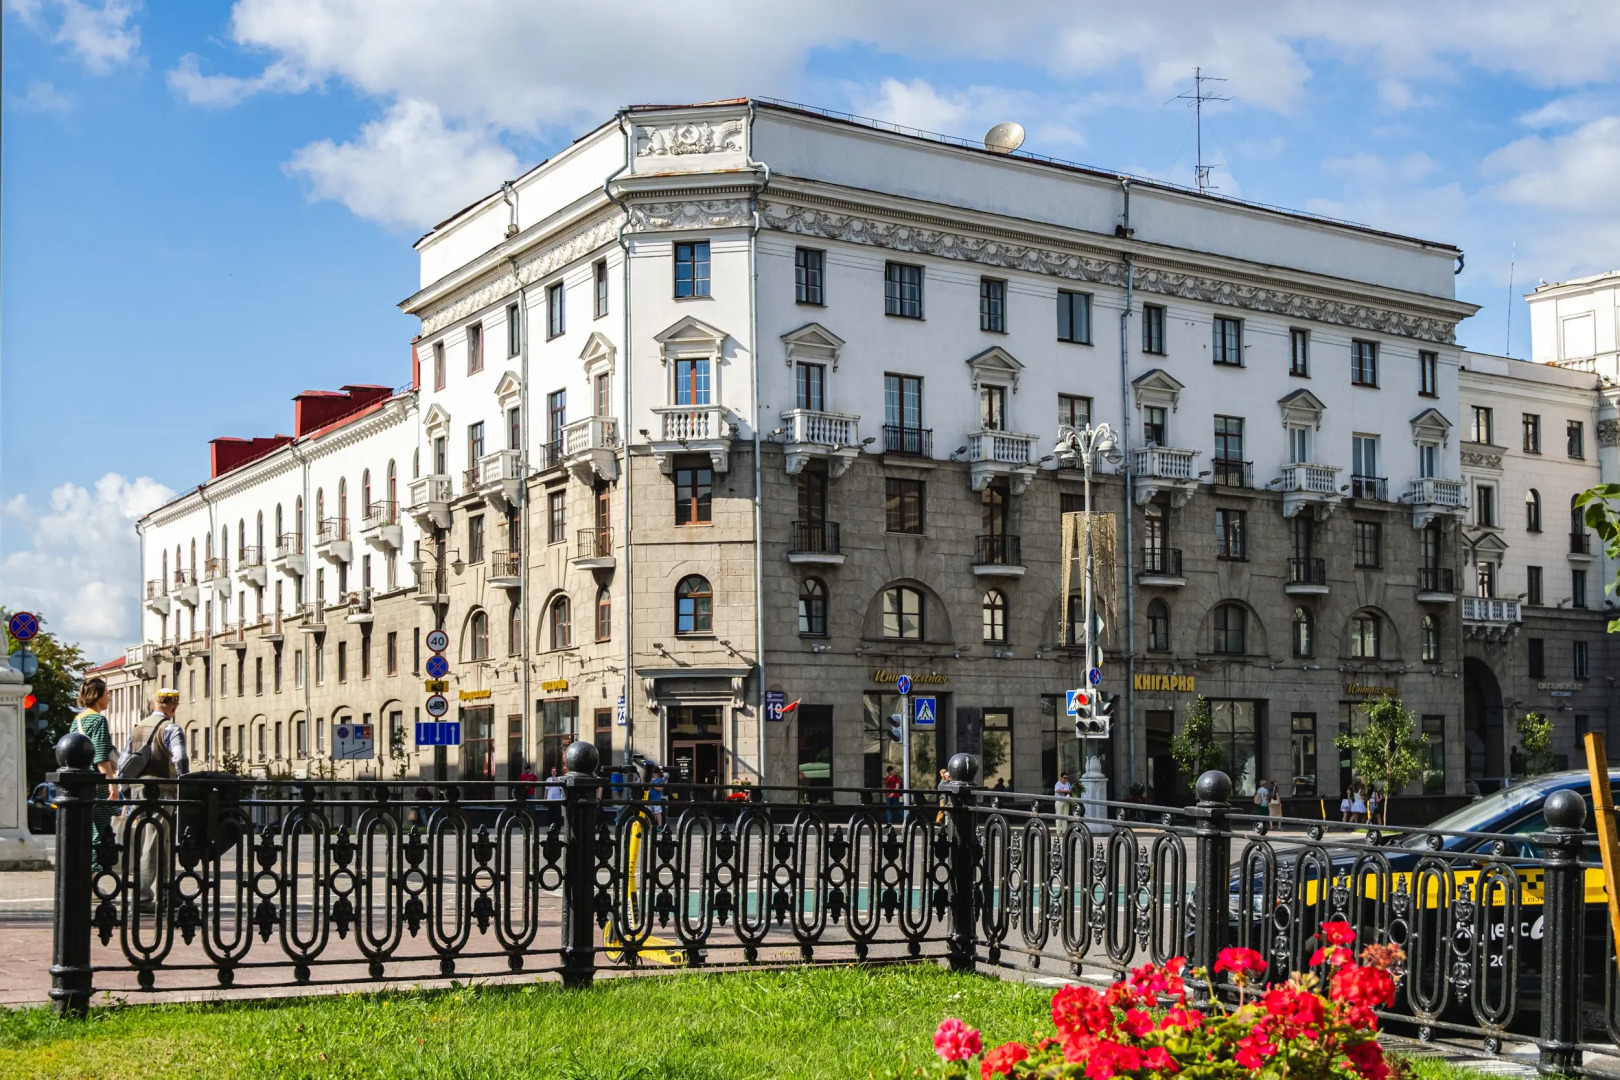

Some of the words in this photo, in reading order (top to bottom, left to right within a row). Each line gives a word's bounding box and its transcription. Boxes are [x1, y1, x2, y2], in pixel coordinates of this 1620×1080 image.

[430, 636, 445, 646] 40
[1134, 674, 1195, 691] КНІГАРНЯ
[767, 702, 783, 720] 19
